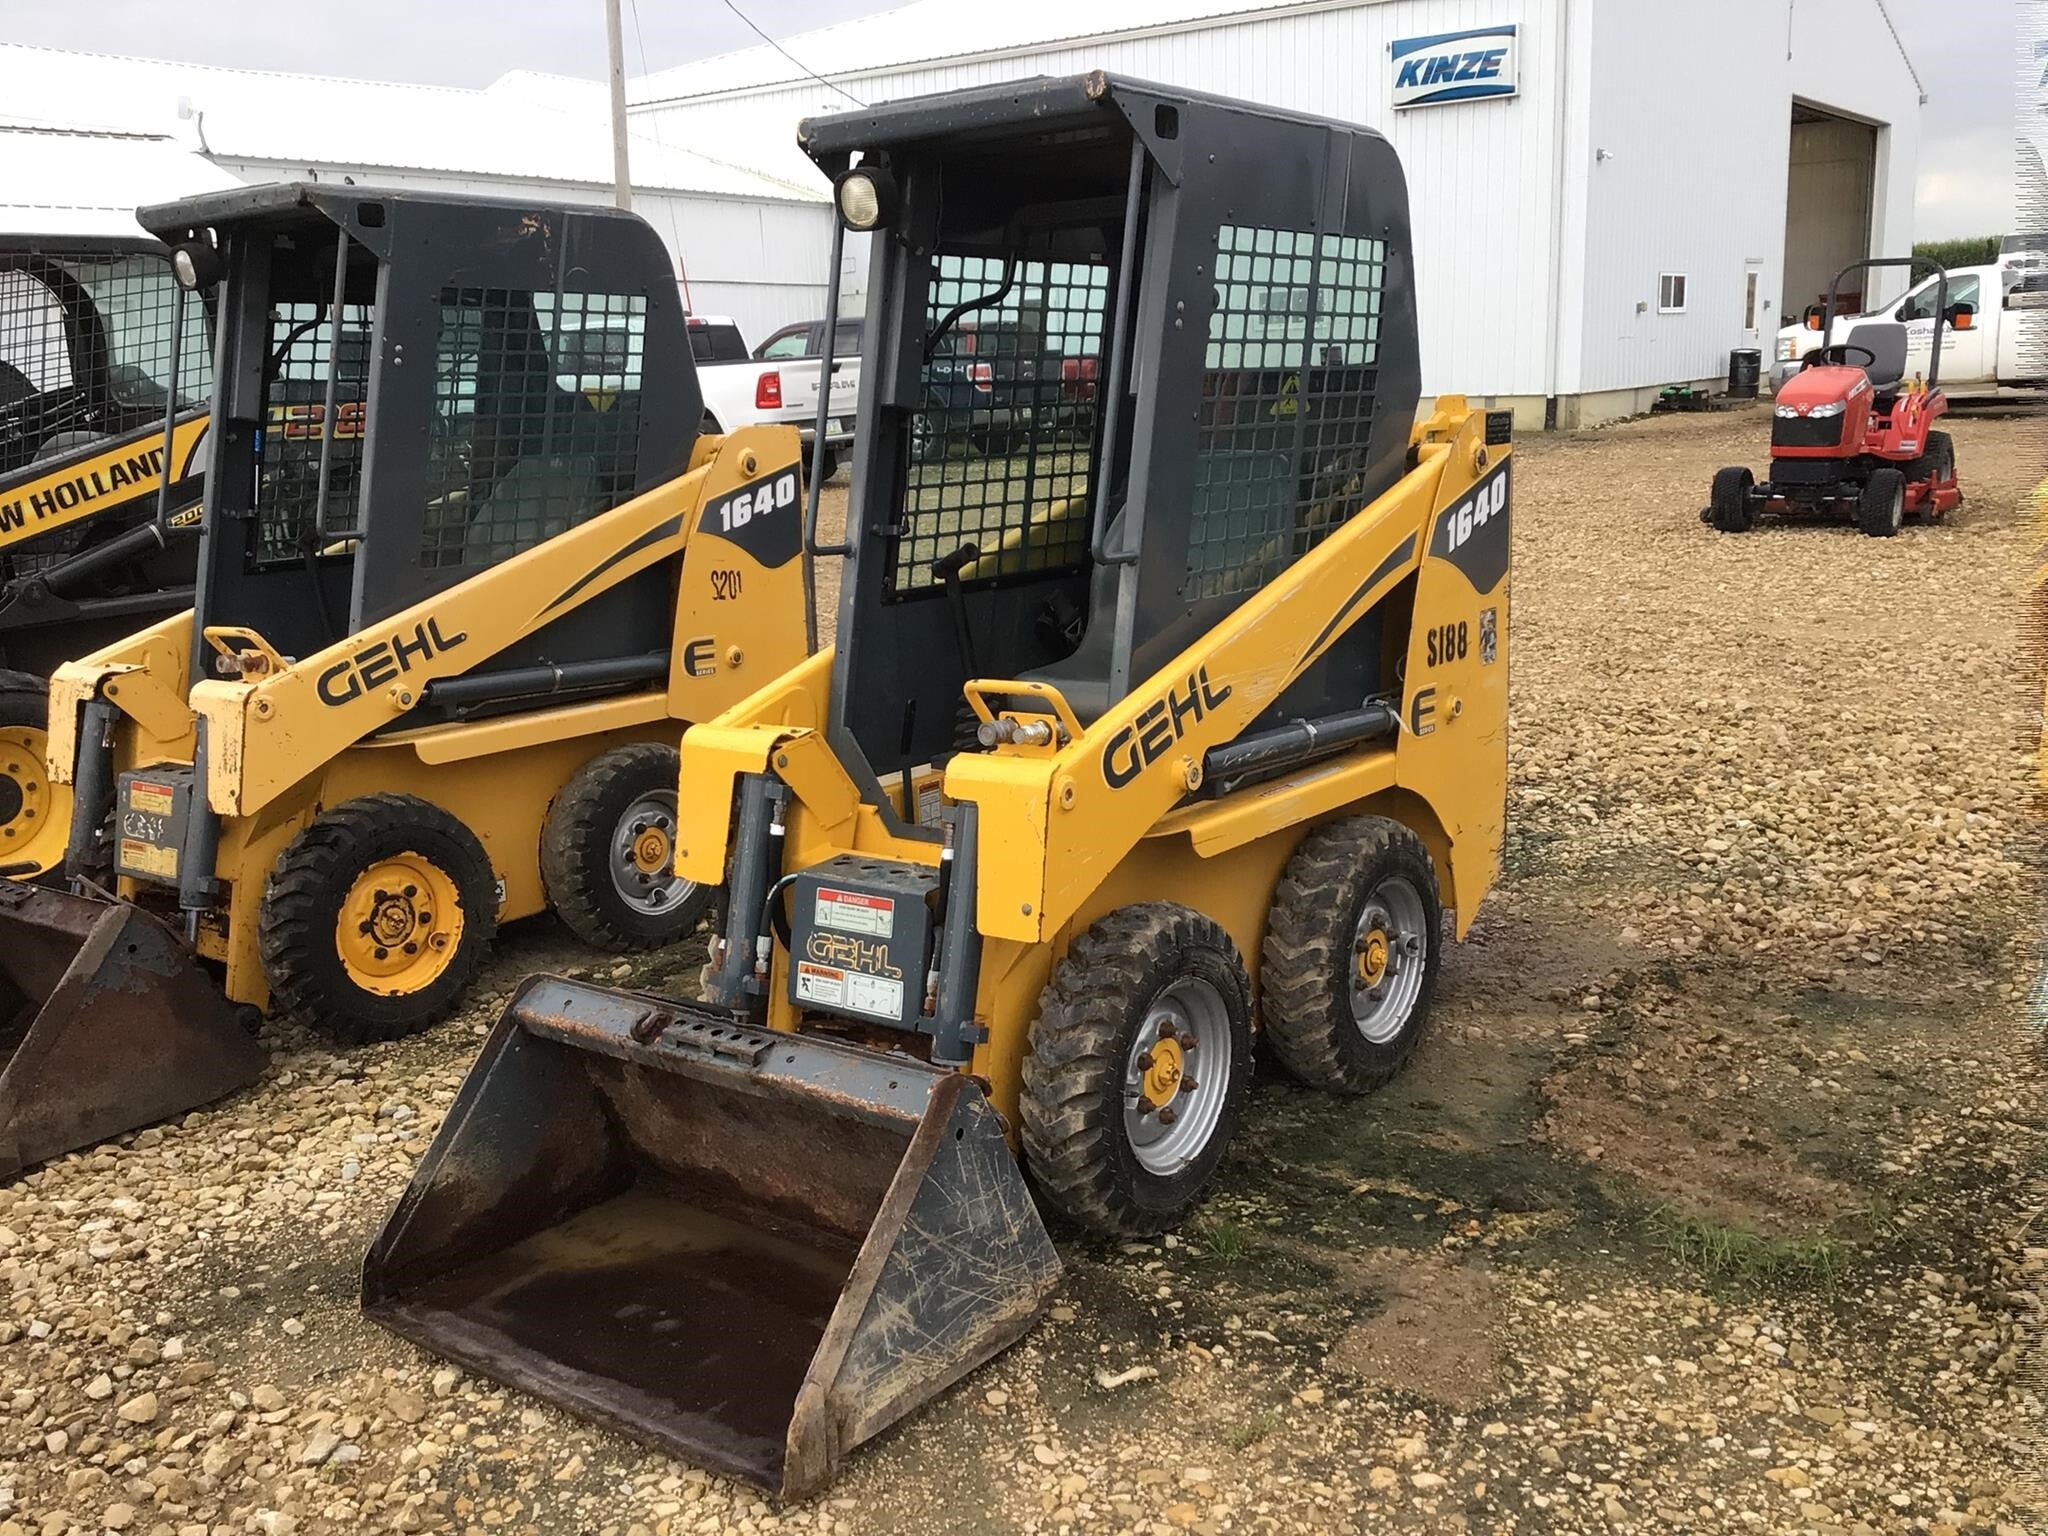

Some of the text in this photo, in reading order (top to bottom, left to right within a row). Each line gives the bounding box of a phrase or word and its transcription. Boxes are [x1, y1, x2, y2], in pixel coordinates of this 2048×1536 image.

[1395, 48, 1508, 88] KINZE
[719, 473, 795, 532] 1640
[1447, 471, 1506, 553] 1640
[711, 570, 742, 600] S201
[317, 616, 468, 706] GEHL
[684, 639, 715, 677] E
[1427, 621, 1468, 668] S188
[1103, 664, 1232, 789] GEHL
[1411, 687, 1436, 737] E
[843, 895, 870, 906] DANGER
[806, 931, 903, 979] GEHL
[810, 967, 839, 979] WARNING
